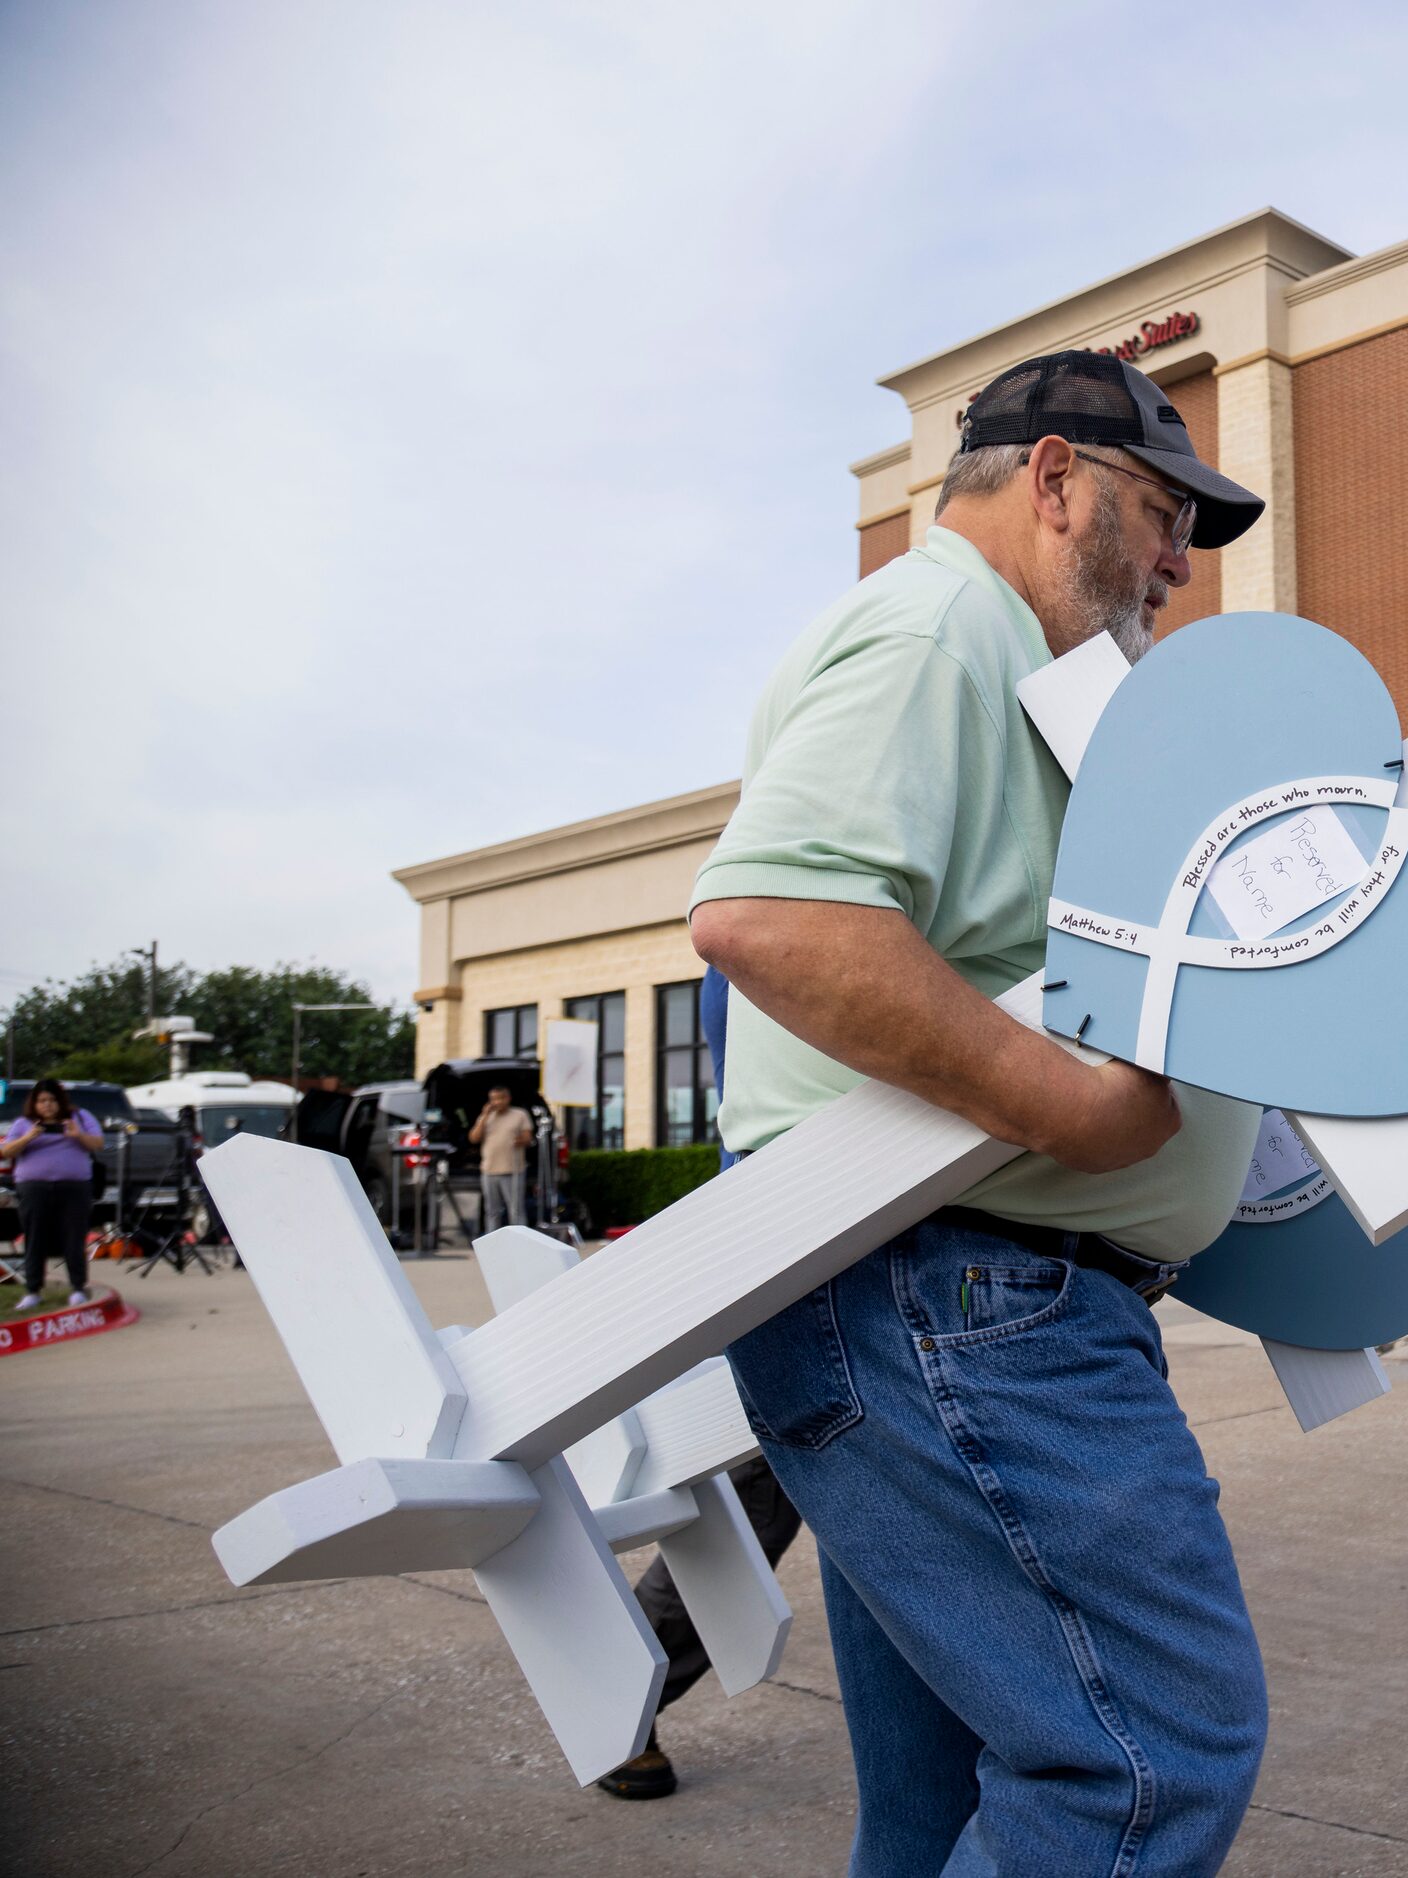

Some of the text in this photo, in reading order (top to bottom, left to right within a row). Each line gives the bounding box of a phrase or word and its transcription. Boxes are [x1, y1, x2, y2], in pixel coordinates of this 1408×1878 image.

[1131, 312, 1200, 354] Suites
[1182, 840, 1217, 889] Blessed
[1217, 821, 1238, 841] are
[1238, 799, 1278, 821] those
[1281, 787, 1309, 802] who
[1269, 855, 1294, 880] for
[1290, 817, 1344, 896] Reserved
[1381, 845, 1400, 865] for
[1231, 855, 1274, 919] Name
[1360, 871, 1386, 898] they
[1338, 899, 1360, 924] will
[1059, 913, 1138, 945] Matthew 5:4
[1314, 923, 1335, 937] be
[1296, 1192, 1311, 1202] be
[27, 1308, 106, 1344] PARKING
